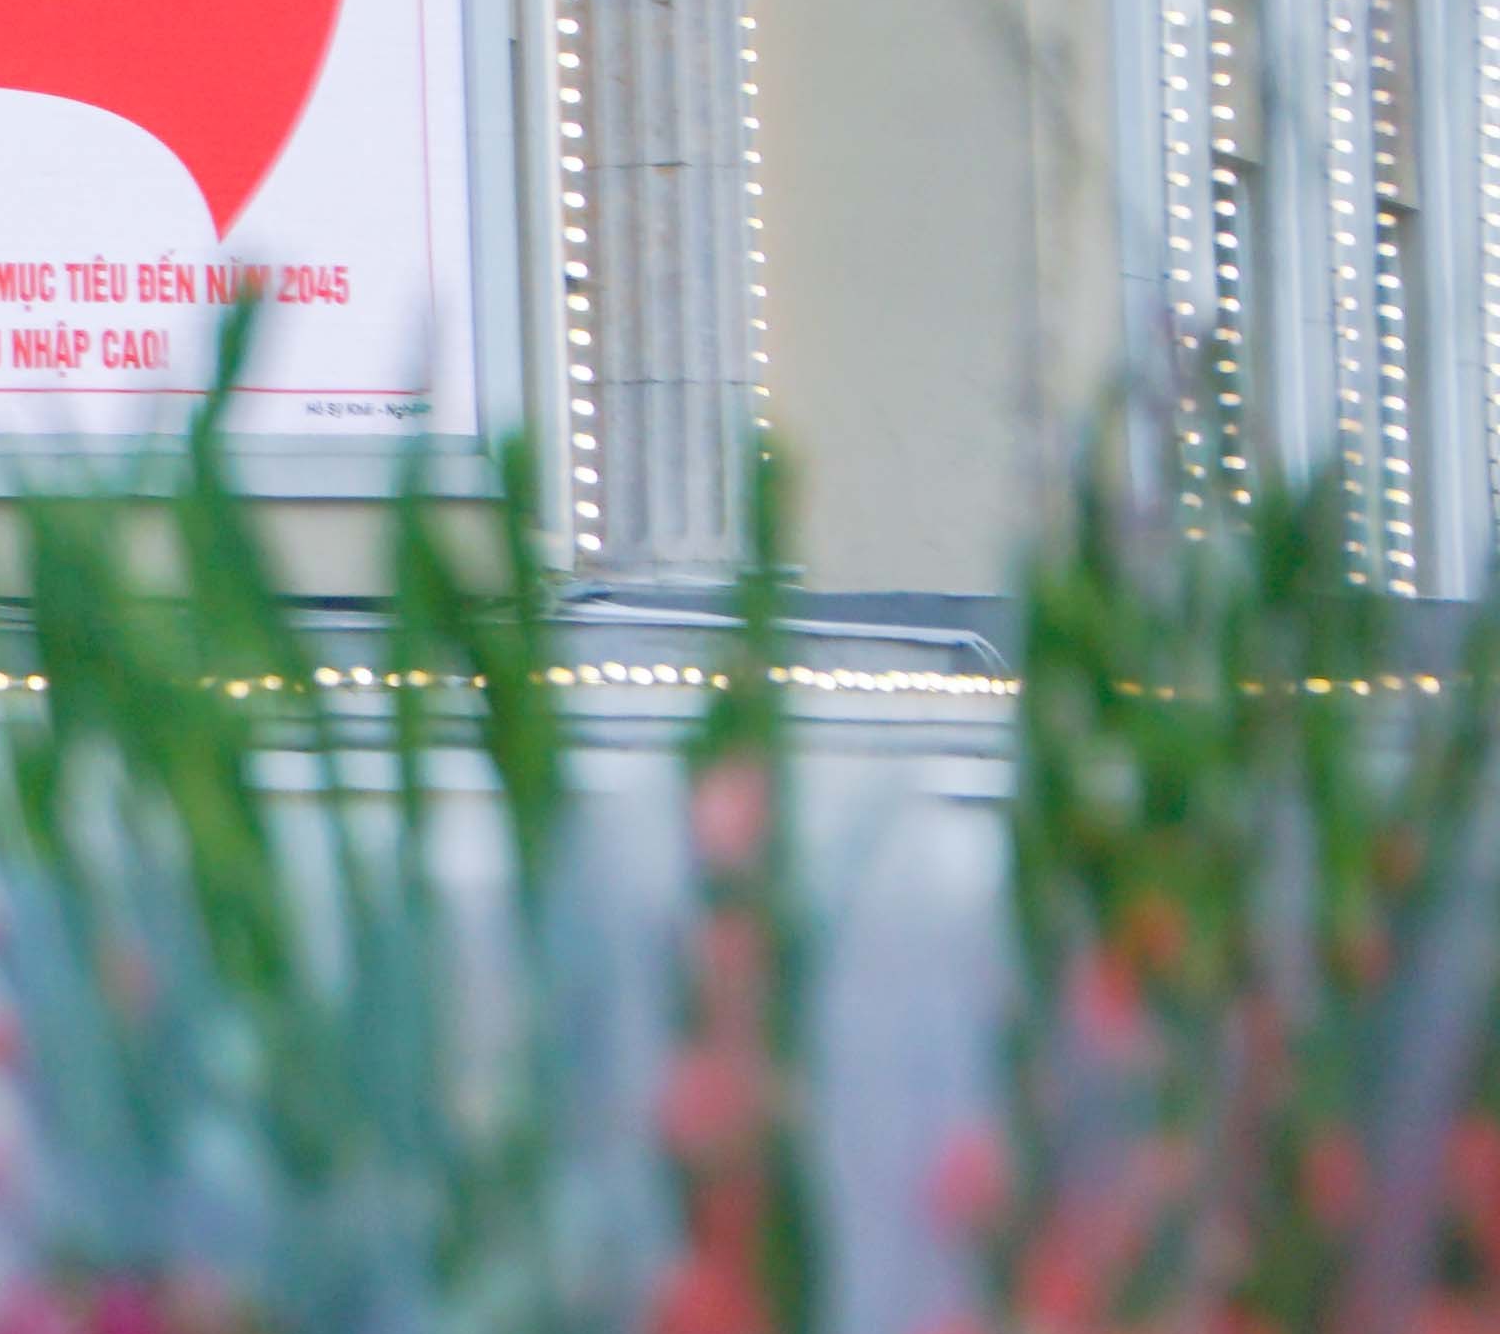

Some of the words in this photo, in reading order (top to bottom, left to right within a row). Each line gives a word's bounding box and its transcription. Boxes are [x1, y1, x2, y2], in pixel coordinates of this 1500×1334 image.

[65, 255, 127, 303] TIÊU
[137, 249, 195, 304] ĐẾN
[276, 265, 350, 305] 2045
[11, 321, 91, 378] NHẬP
[102, 328, 170, 371] CAO!
